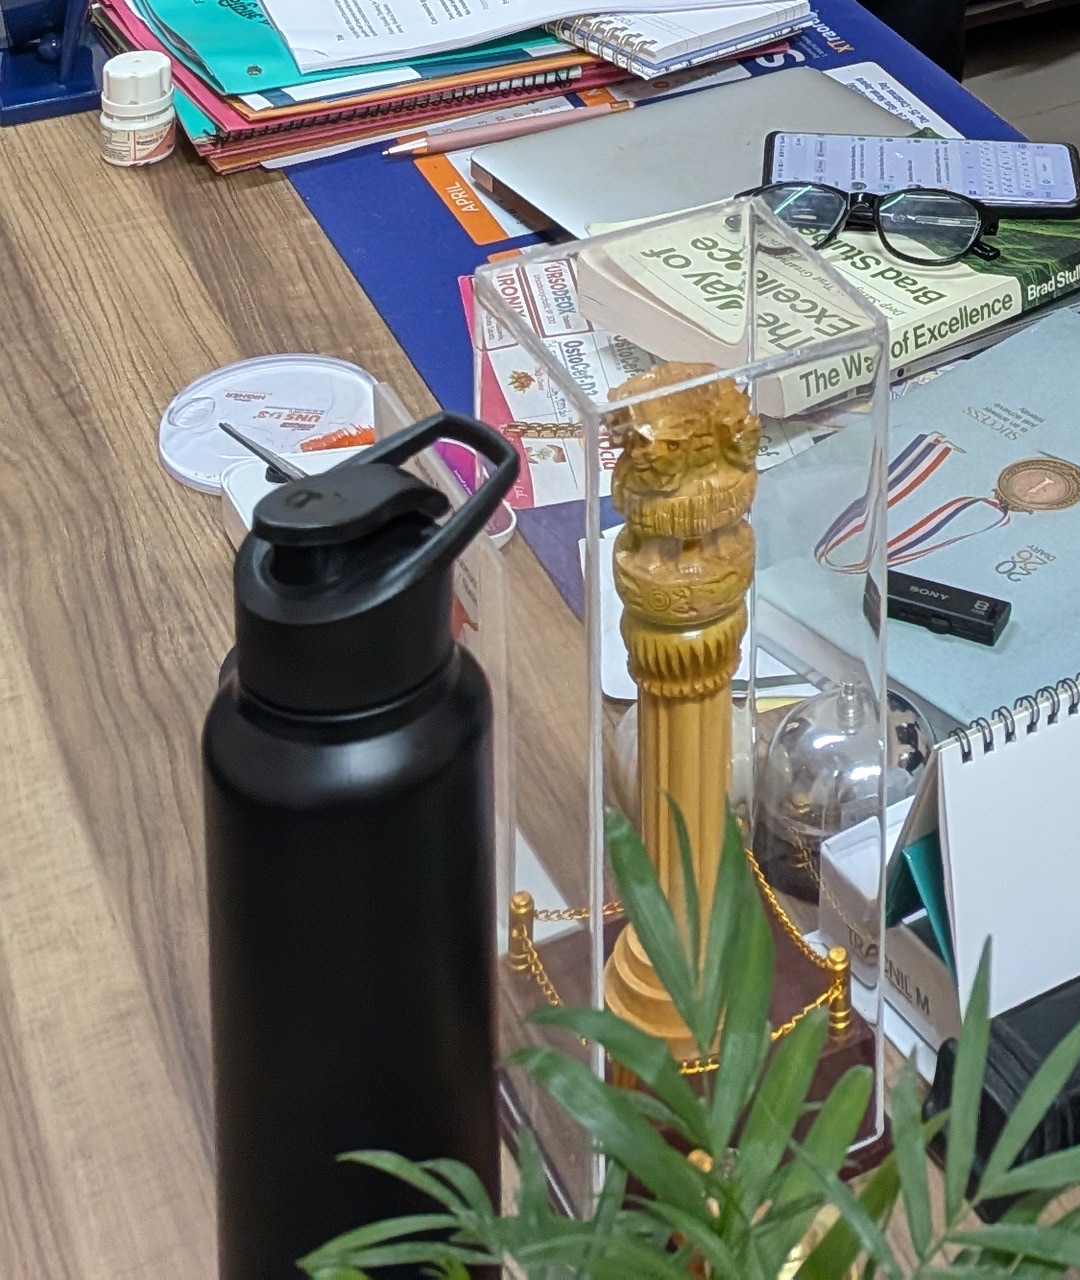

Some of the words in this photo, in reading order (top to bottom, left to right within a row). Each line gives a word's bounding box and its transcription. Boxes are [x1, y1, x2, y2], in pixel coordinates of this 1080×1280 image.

[446, 181, 481, 214] APRIL
[640, 246, 693, 270] of
[542, 264, 577, 316] URSODEOX
[878, 265, 949, 308] Brad
[799, 366, 841, 400] The
[841, 351, 878, 384] Wa
[890, 330, 912, 360] of
[914, 292, 1014, 350] Excellence
[1026, 275, 1056, 303] Brad
[1026, 543, 1057, 563] DIARY
[995, 558, 1034, 582] 20
[908, 584, 950, 602] SONY
